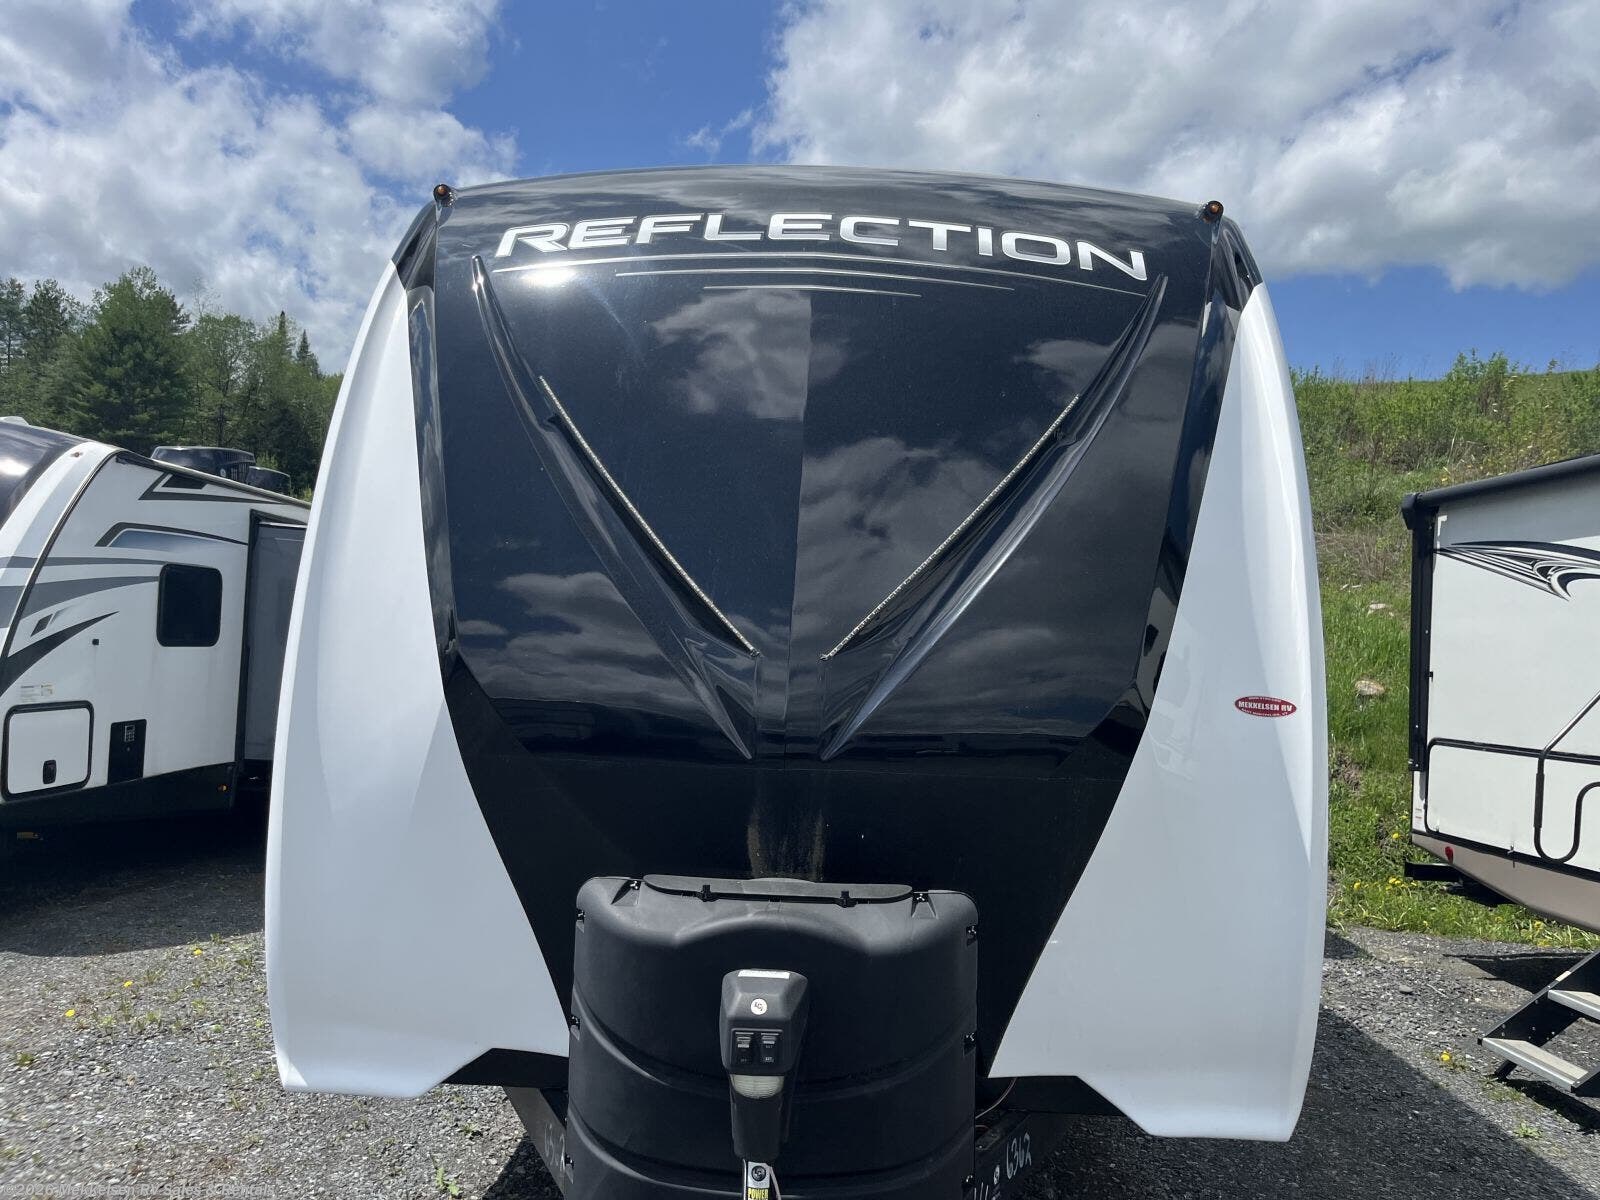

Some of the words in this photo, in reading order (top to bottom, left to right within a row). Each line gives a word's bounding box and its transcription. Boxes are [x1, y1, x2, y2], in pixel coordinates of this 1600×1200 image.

[494, 212, 1149, 281] REFLECTION
[1238, 701, 1280, 711] MEKKELSEN
[1281, 704, 1293, 712] RV
[748, 1188, 769, 1199] POWER
